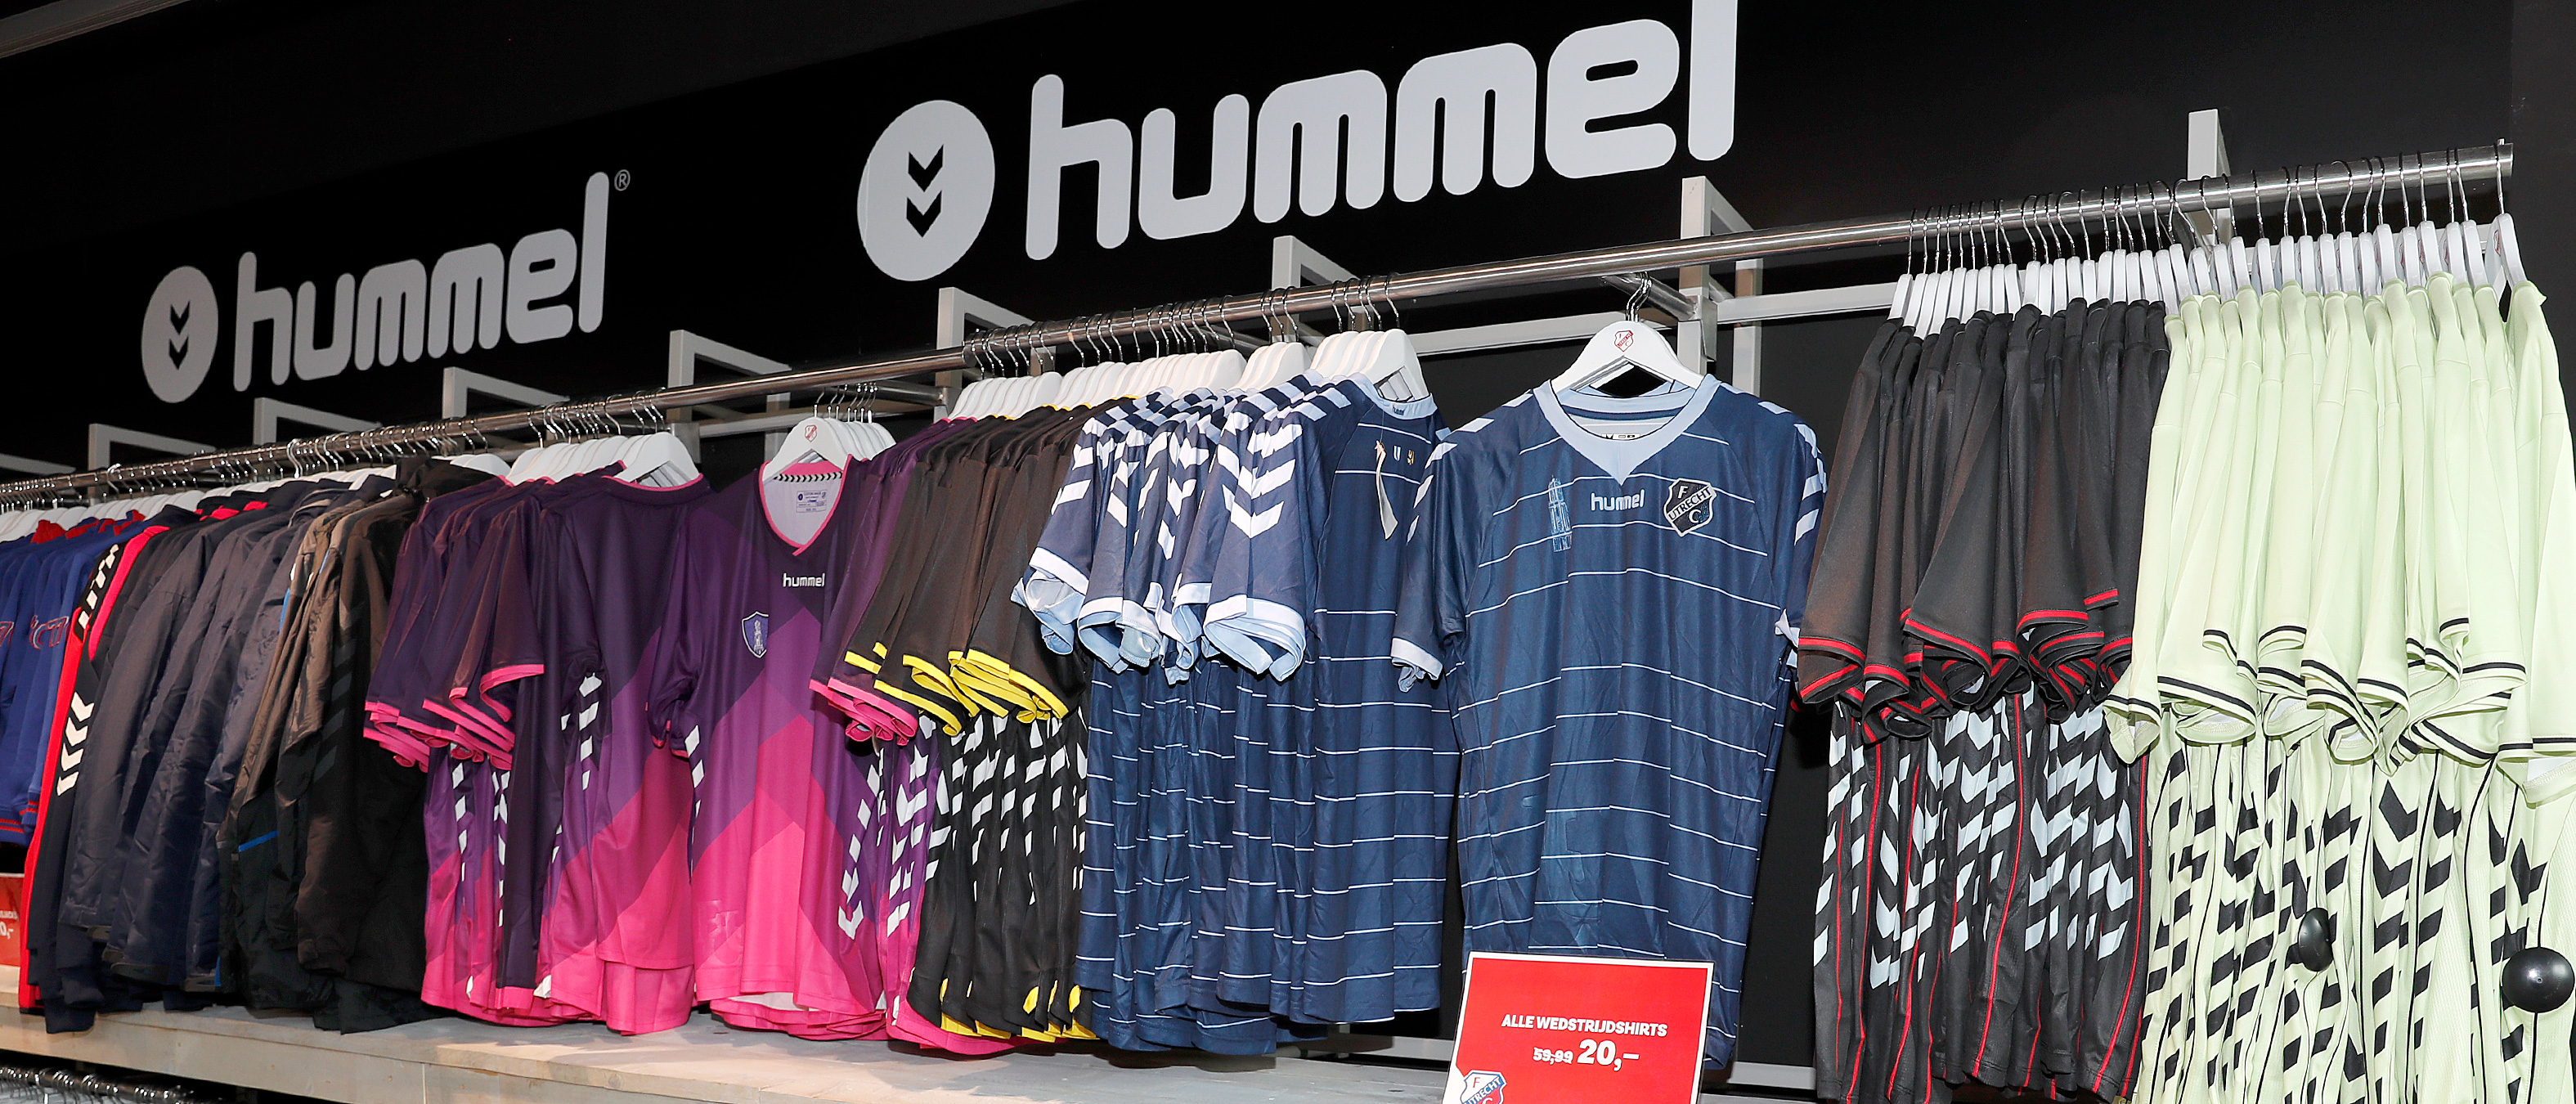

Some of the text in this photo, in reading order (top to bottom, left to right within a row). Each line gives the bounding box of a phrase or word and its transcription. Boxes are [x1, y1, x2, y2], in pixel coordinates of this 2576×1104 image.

[1025, 0, 1739, 261] hummel
[233, 172, 610, 392] hummel
[1591, 489, 1645, 511] hummel
[1669, 487, 1712, 520] UTRECHT
[1678, 486, 1689, 499] F
[1689, 509, 1702, 523] C
[783, 572, 825, 587] hummel
[1501, 1014, 1668, 1037] ALLE WEDSTRIJDSHIRTS
[1533, 1039, 1640, 1071] 59,99 20,-
[1473, 1076, 1481, 1088] F
